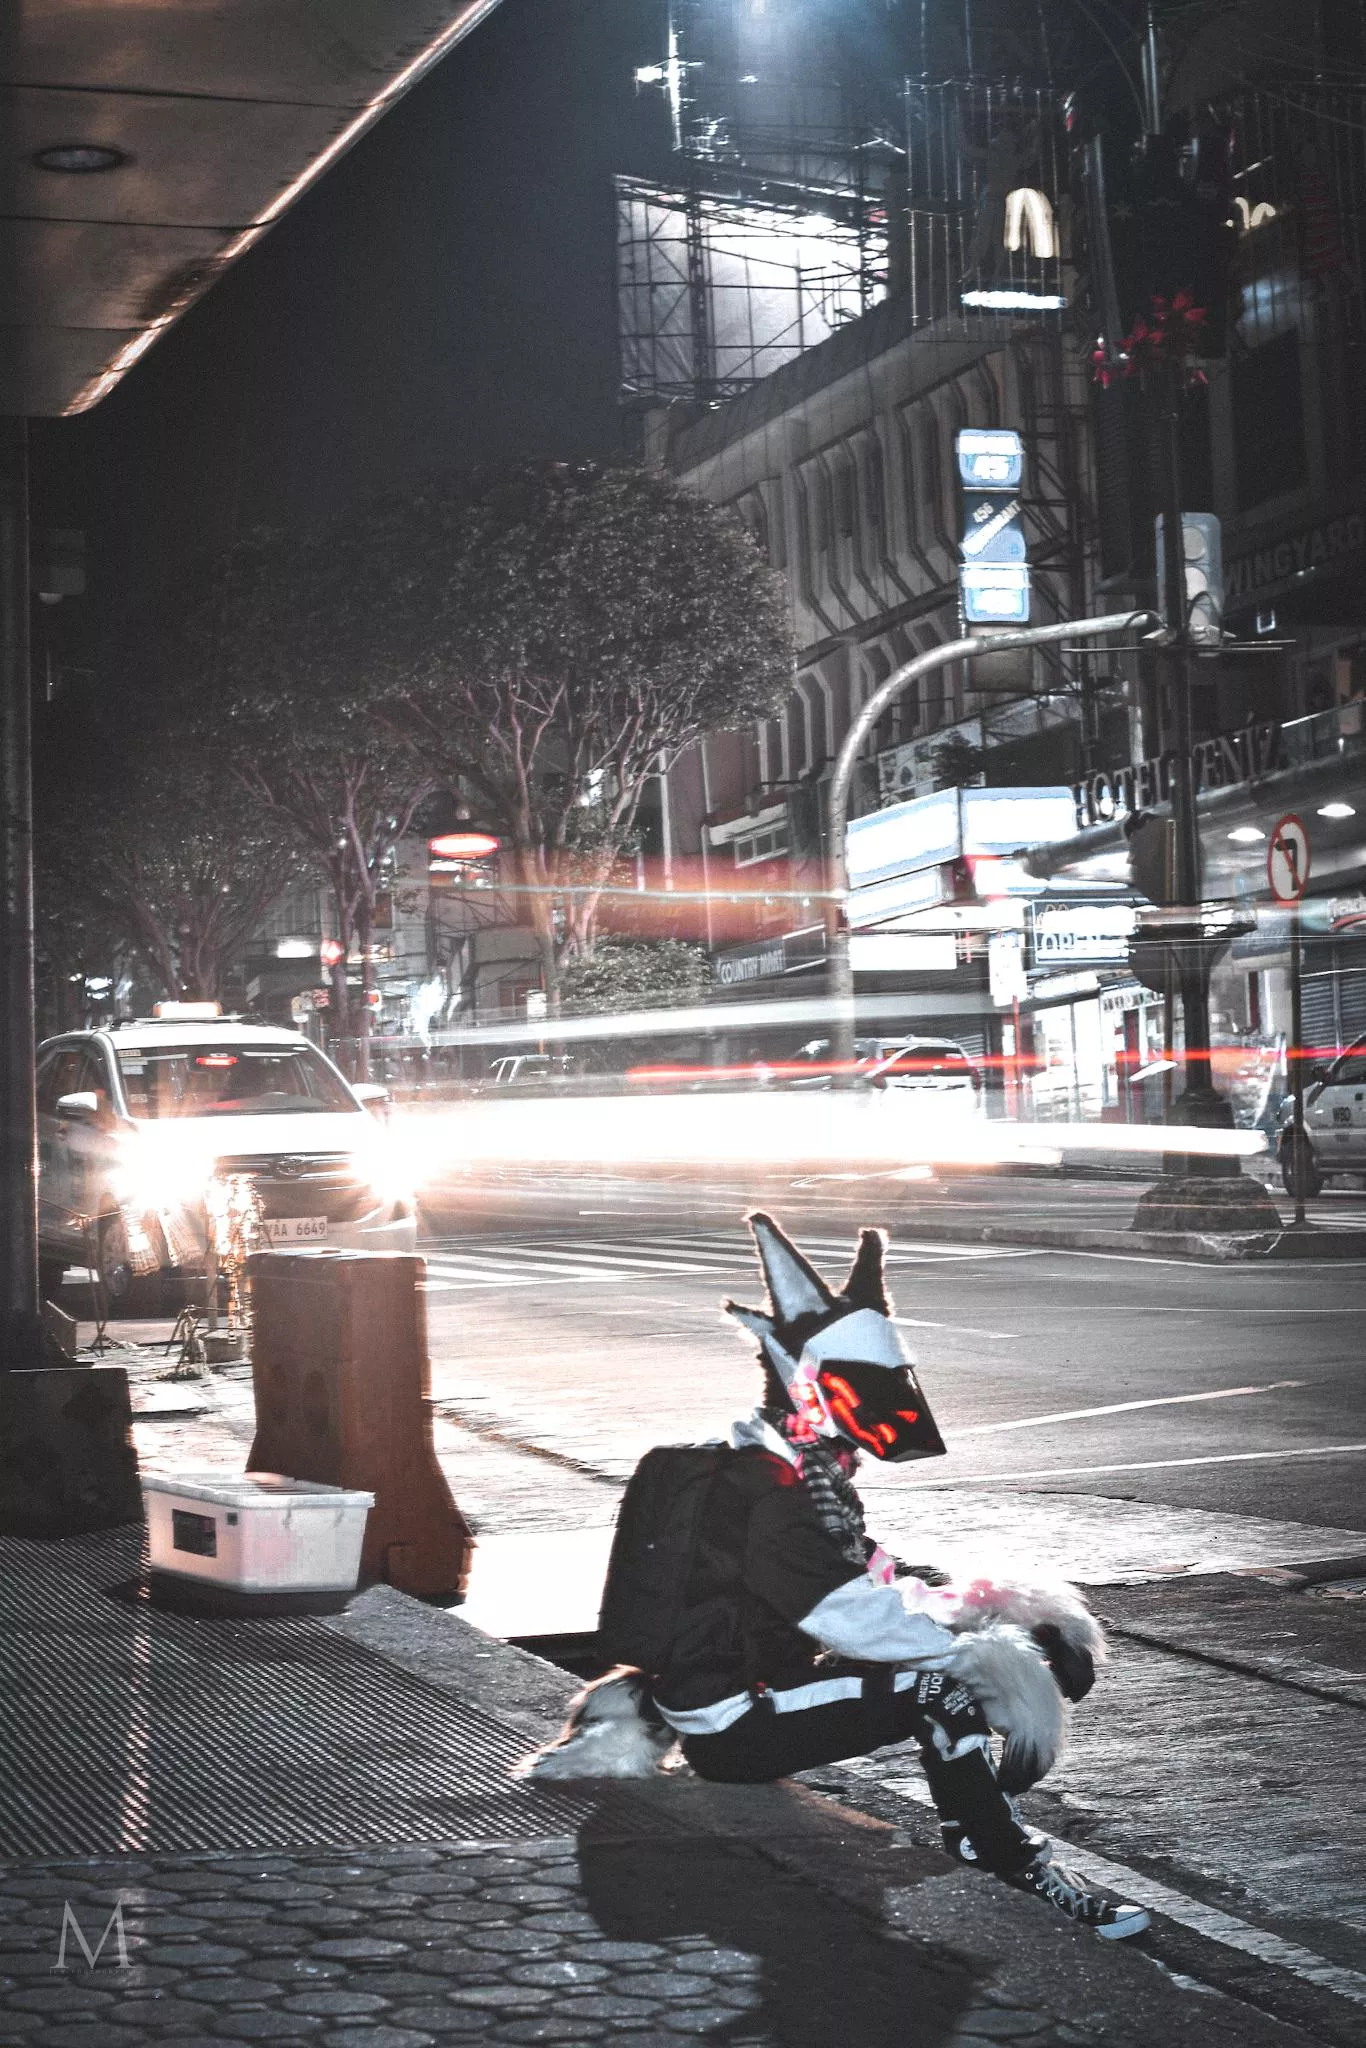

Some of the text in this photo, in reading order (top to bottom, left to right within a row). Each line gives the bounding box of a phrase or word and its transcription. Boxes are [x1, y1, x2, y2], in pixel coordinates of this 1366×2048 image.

[1072, 720, 1288, 830] HOTEL ENIZ
[296, 1221, 326, 1236] 6649
